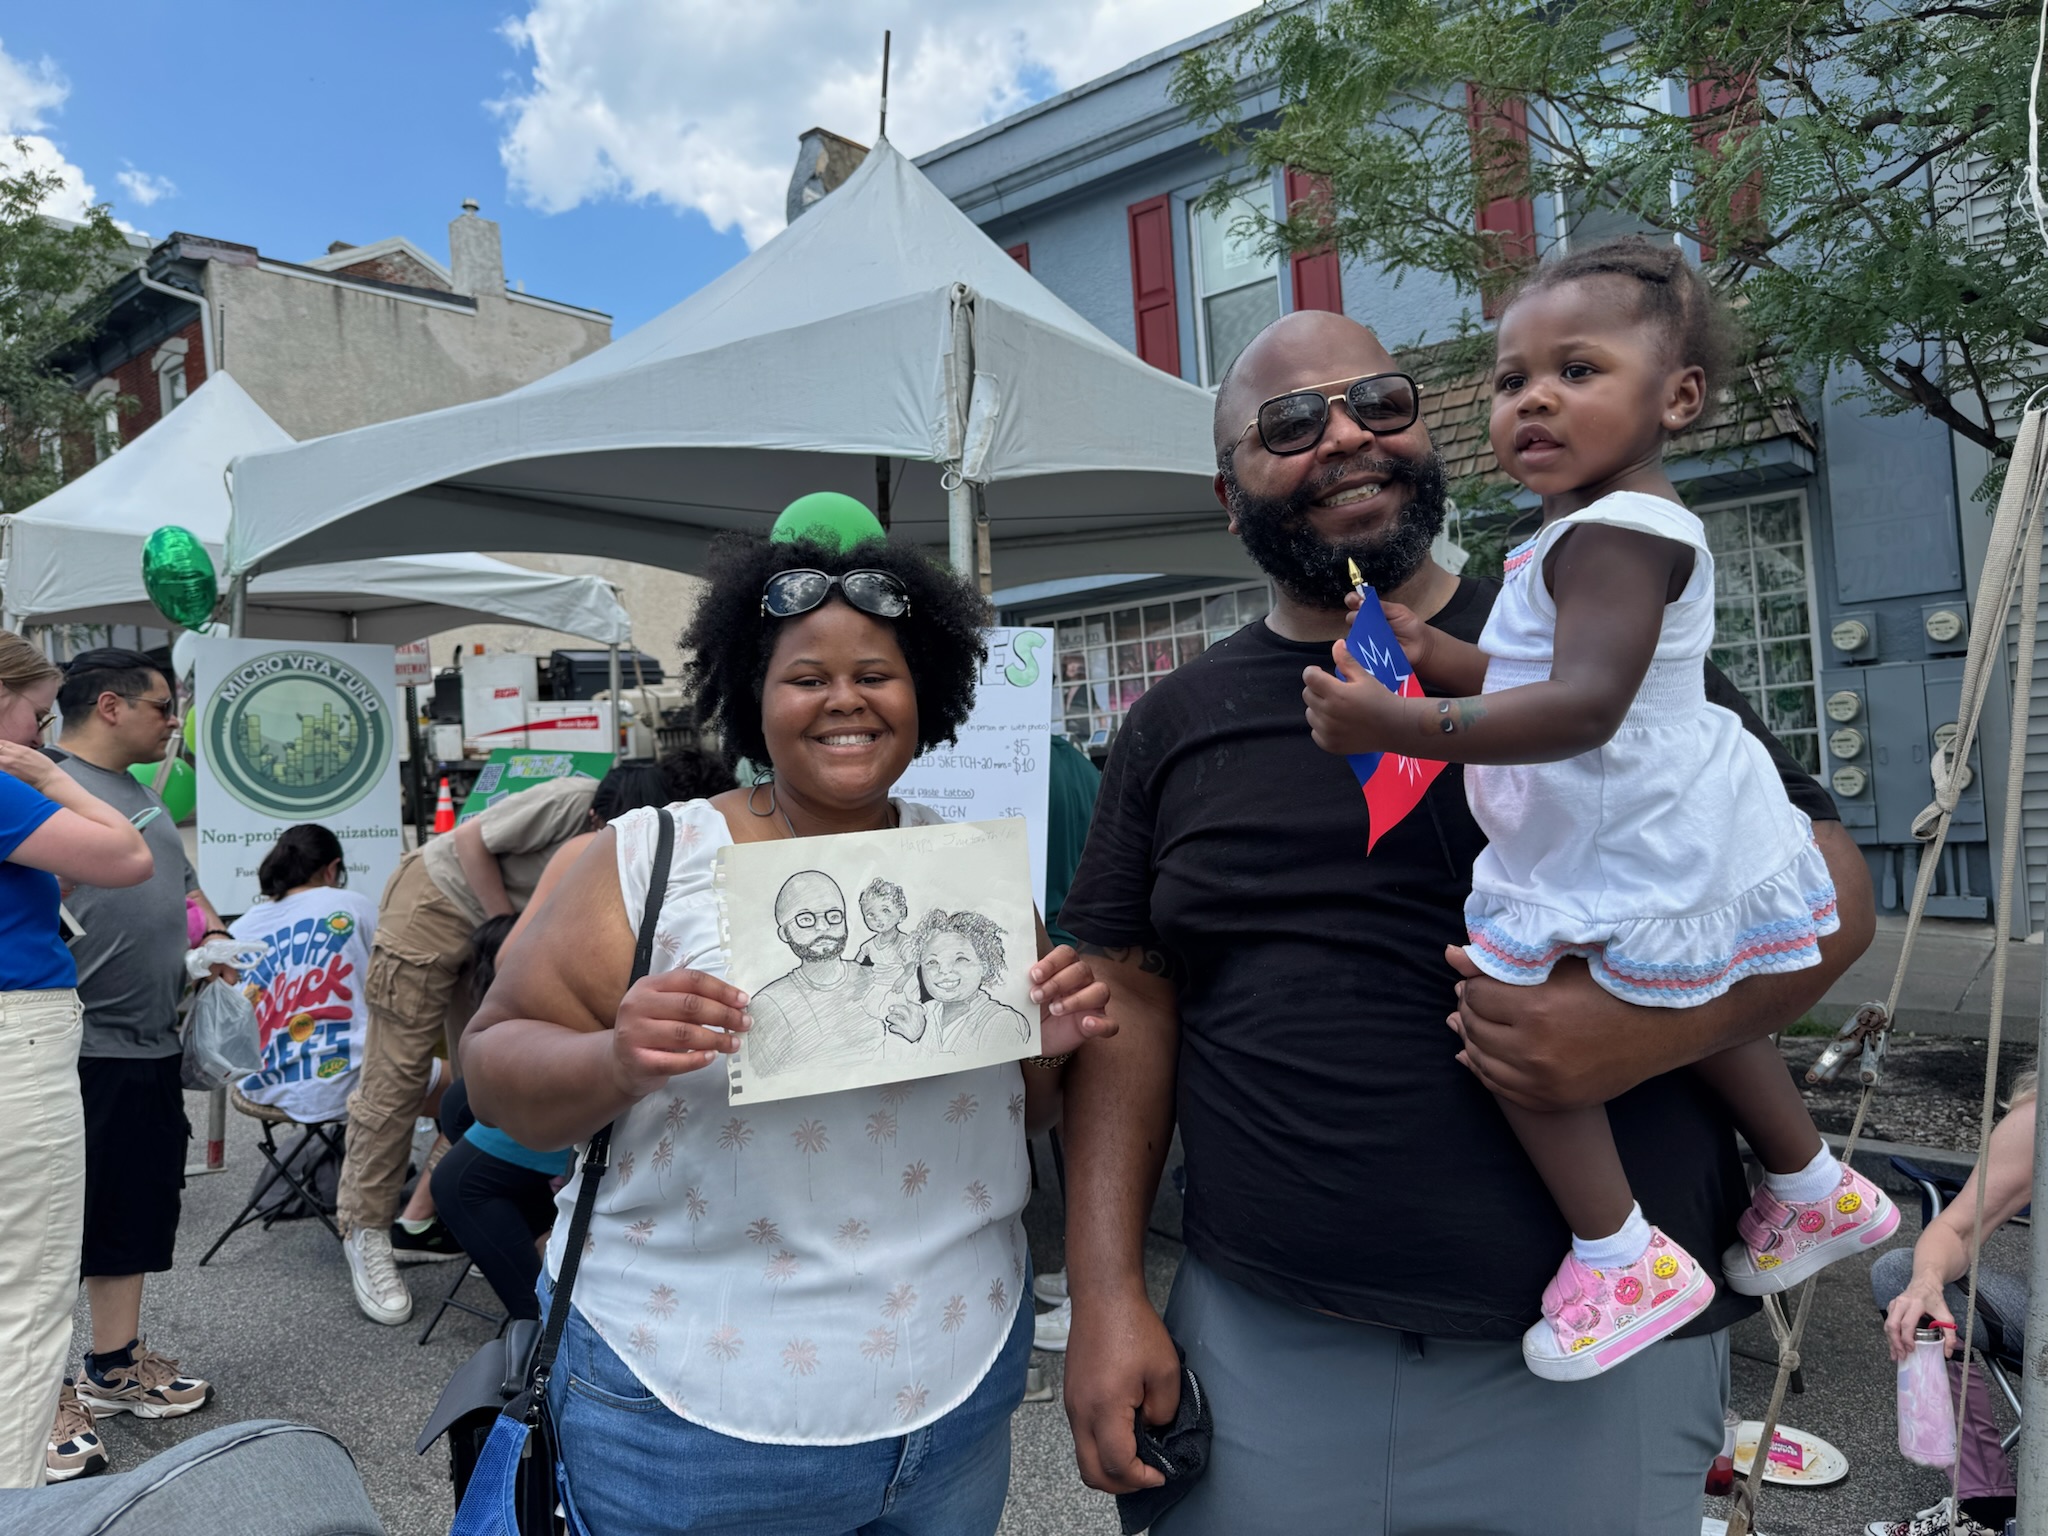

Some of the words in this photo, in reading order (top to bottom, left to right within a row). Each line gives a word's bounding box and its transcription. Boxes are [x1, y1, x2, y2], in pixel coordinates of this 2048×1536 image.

[395, 663, 428, 676] RIVEWAY
[220, 656, 283, 702] MICRO
[288, 655, 331, 677] VRA
[335, 667, 380, 712] FUND
[977, 724, 997, 734] person
[1011, 722, 1026, 731] with
[1028, 722, 1050, 733] photo)
[1013, 738, 1031, 757] $5
[911, 755, 936, 769] ILED
[890, 786, 915, 796] ultural
[943, 787, 975, 799] tattoo)
[931, 804, 967, 818] SIGN
[201, 827, 282, 846] Non-profi
[335, 825, 398, 840] nization
